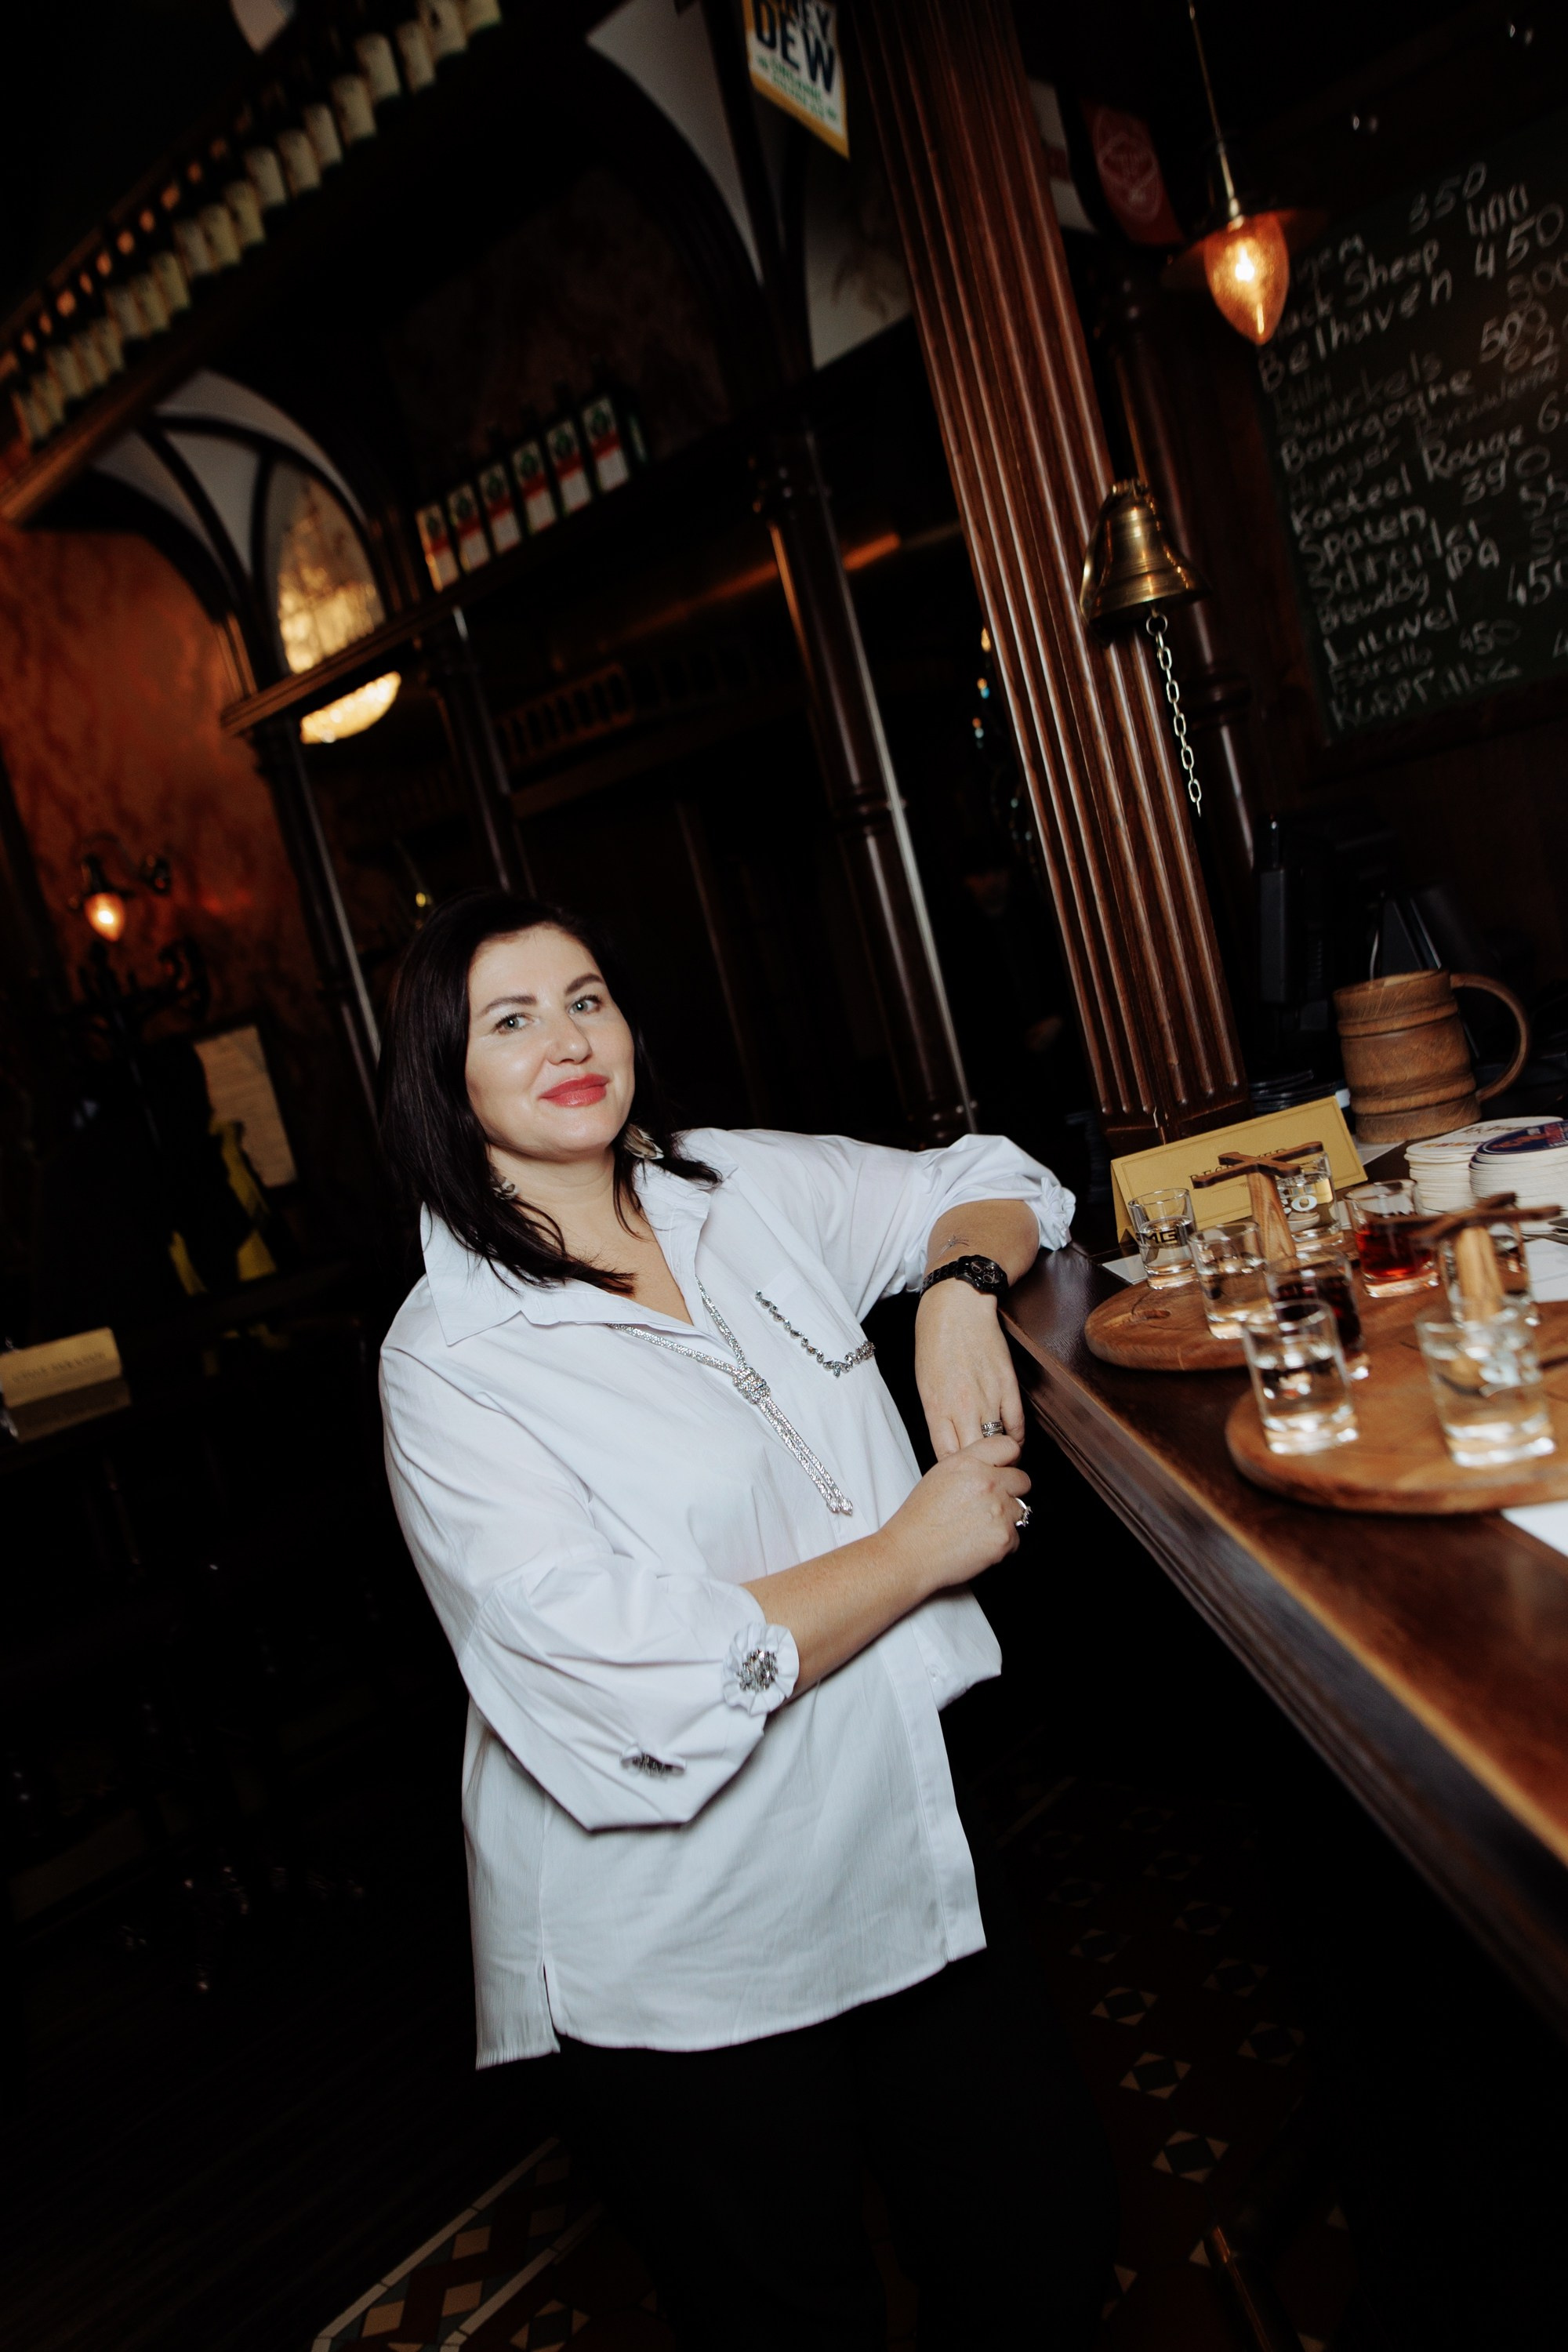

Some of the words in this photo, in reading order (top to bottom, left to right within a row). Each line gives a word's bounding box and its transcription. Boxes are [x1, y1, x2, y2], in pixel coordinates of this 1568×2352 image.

[755, 0, 836, 94] DEW
[1258, 268, 1453, 394] Belhaven
[1473, 201, 1565, 280] 450
[1343, 238, 1440, 308] Sheep
[1466, 182, 1530, 238] 400
[1280, 368, 1473, 475] Bourgogne
[1290, 461, 1411, 537] Kasteel
[1421, 424, 1524, 483] Rouge
[1298, 505, 1427, 575] Spaten
[1461, 444, 1551, 506] 390
[1446, 536, 1501, 583] IPA
[1459, 619, 1522, 655] 450
